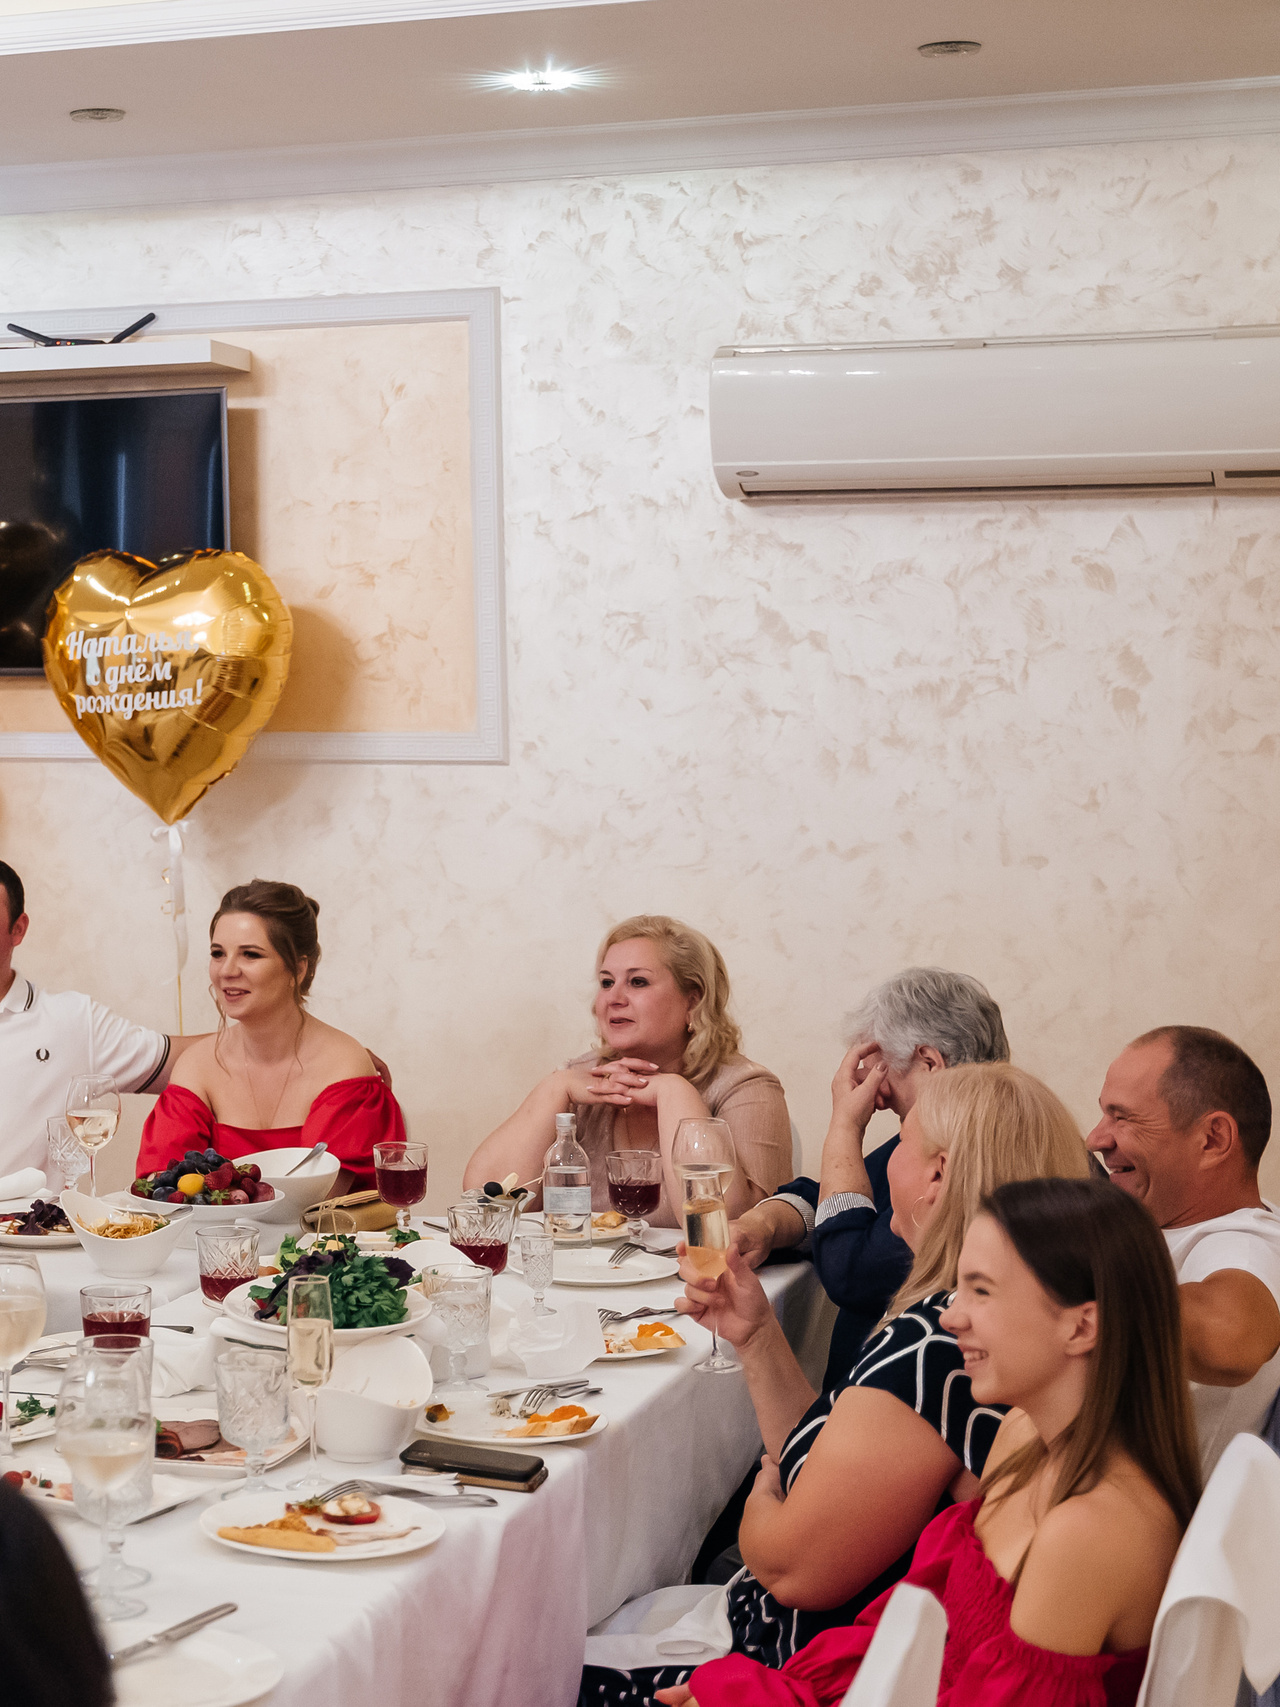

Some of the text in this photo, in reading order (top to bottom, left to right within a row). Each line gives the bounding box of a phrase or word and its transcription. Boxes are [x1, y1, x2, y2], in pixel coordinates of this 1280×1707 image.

[66, 630, 199, 660] Наталья,
[105, 657, 172, 692] днём
[76, 678, 203, 720] рождения!
